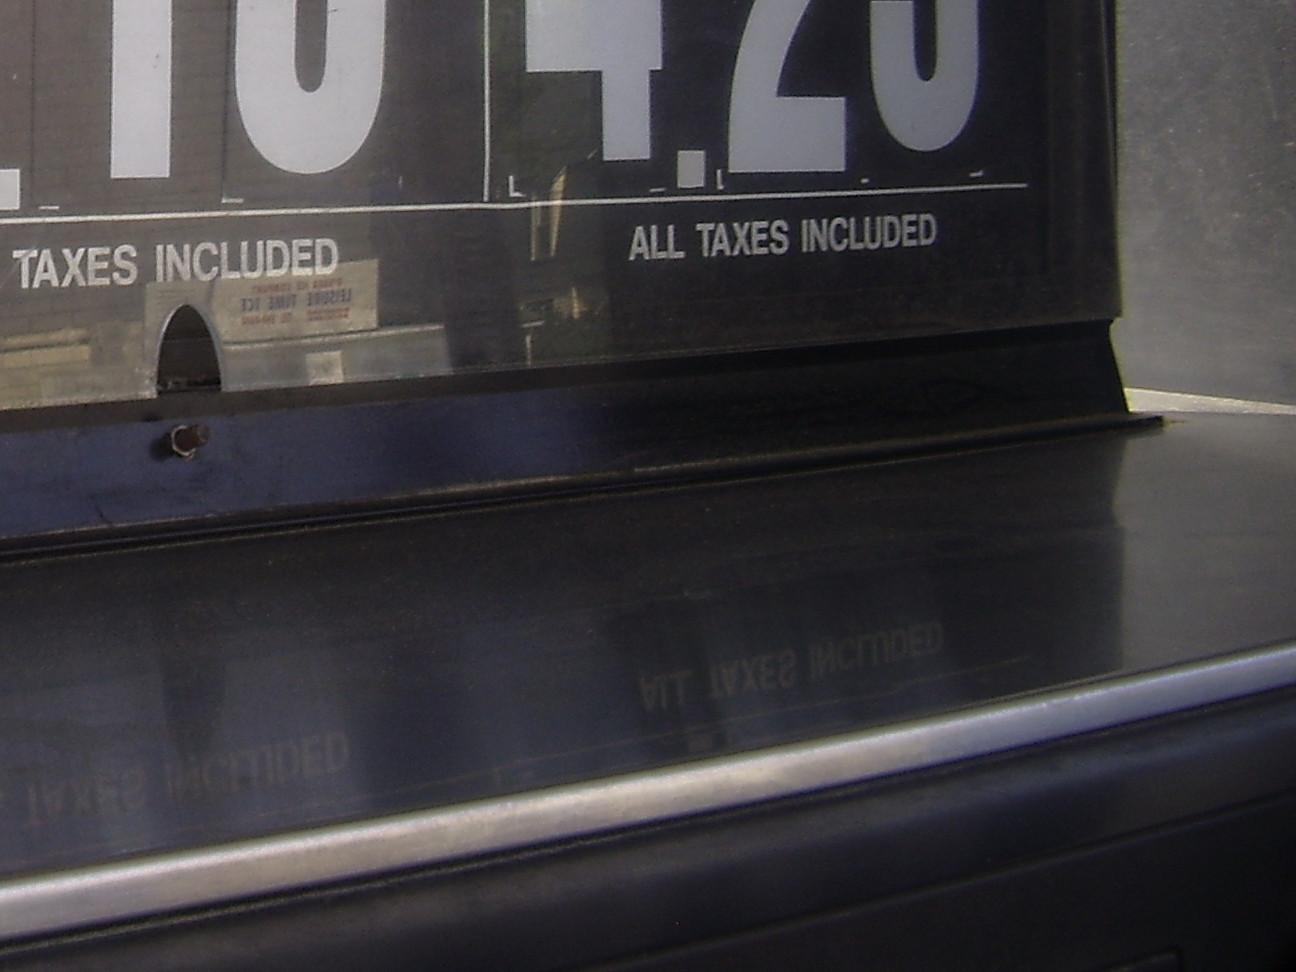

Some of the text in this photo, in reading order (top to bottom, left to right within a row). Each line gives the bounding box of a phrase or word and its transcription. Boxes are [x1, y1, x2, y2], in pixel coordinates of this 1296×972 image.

[628, 212, 937, 261] ALL TAXES INCLUDED
[13, 244, 138, 289] TAXES
[155, 238, 339, 283] INCLUDED
